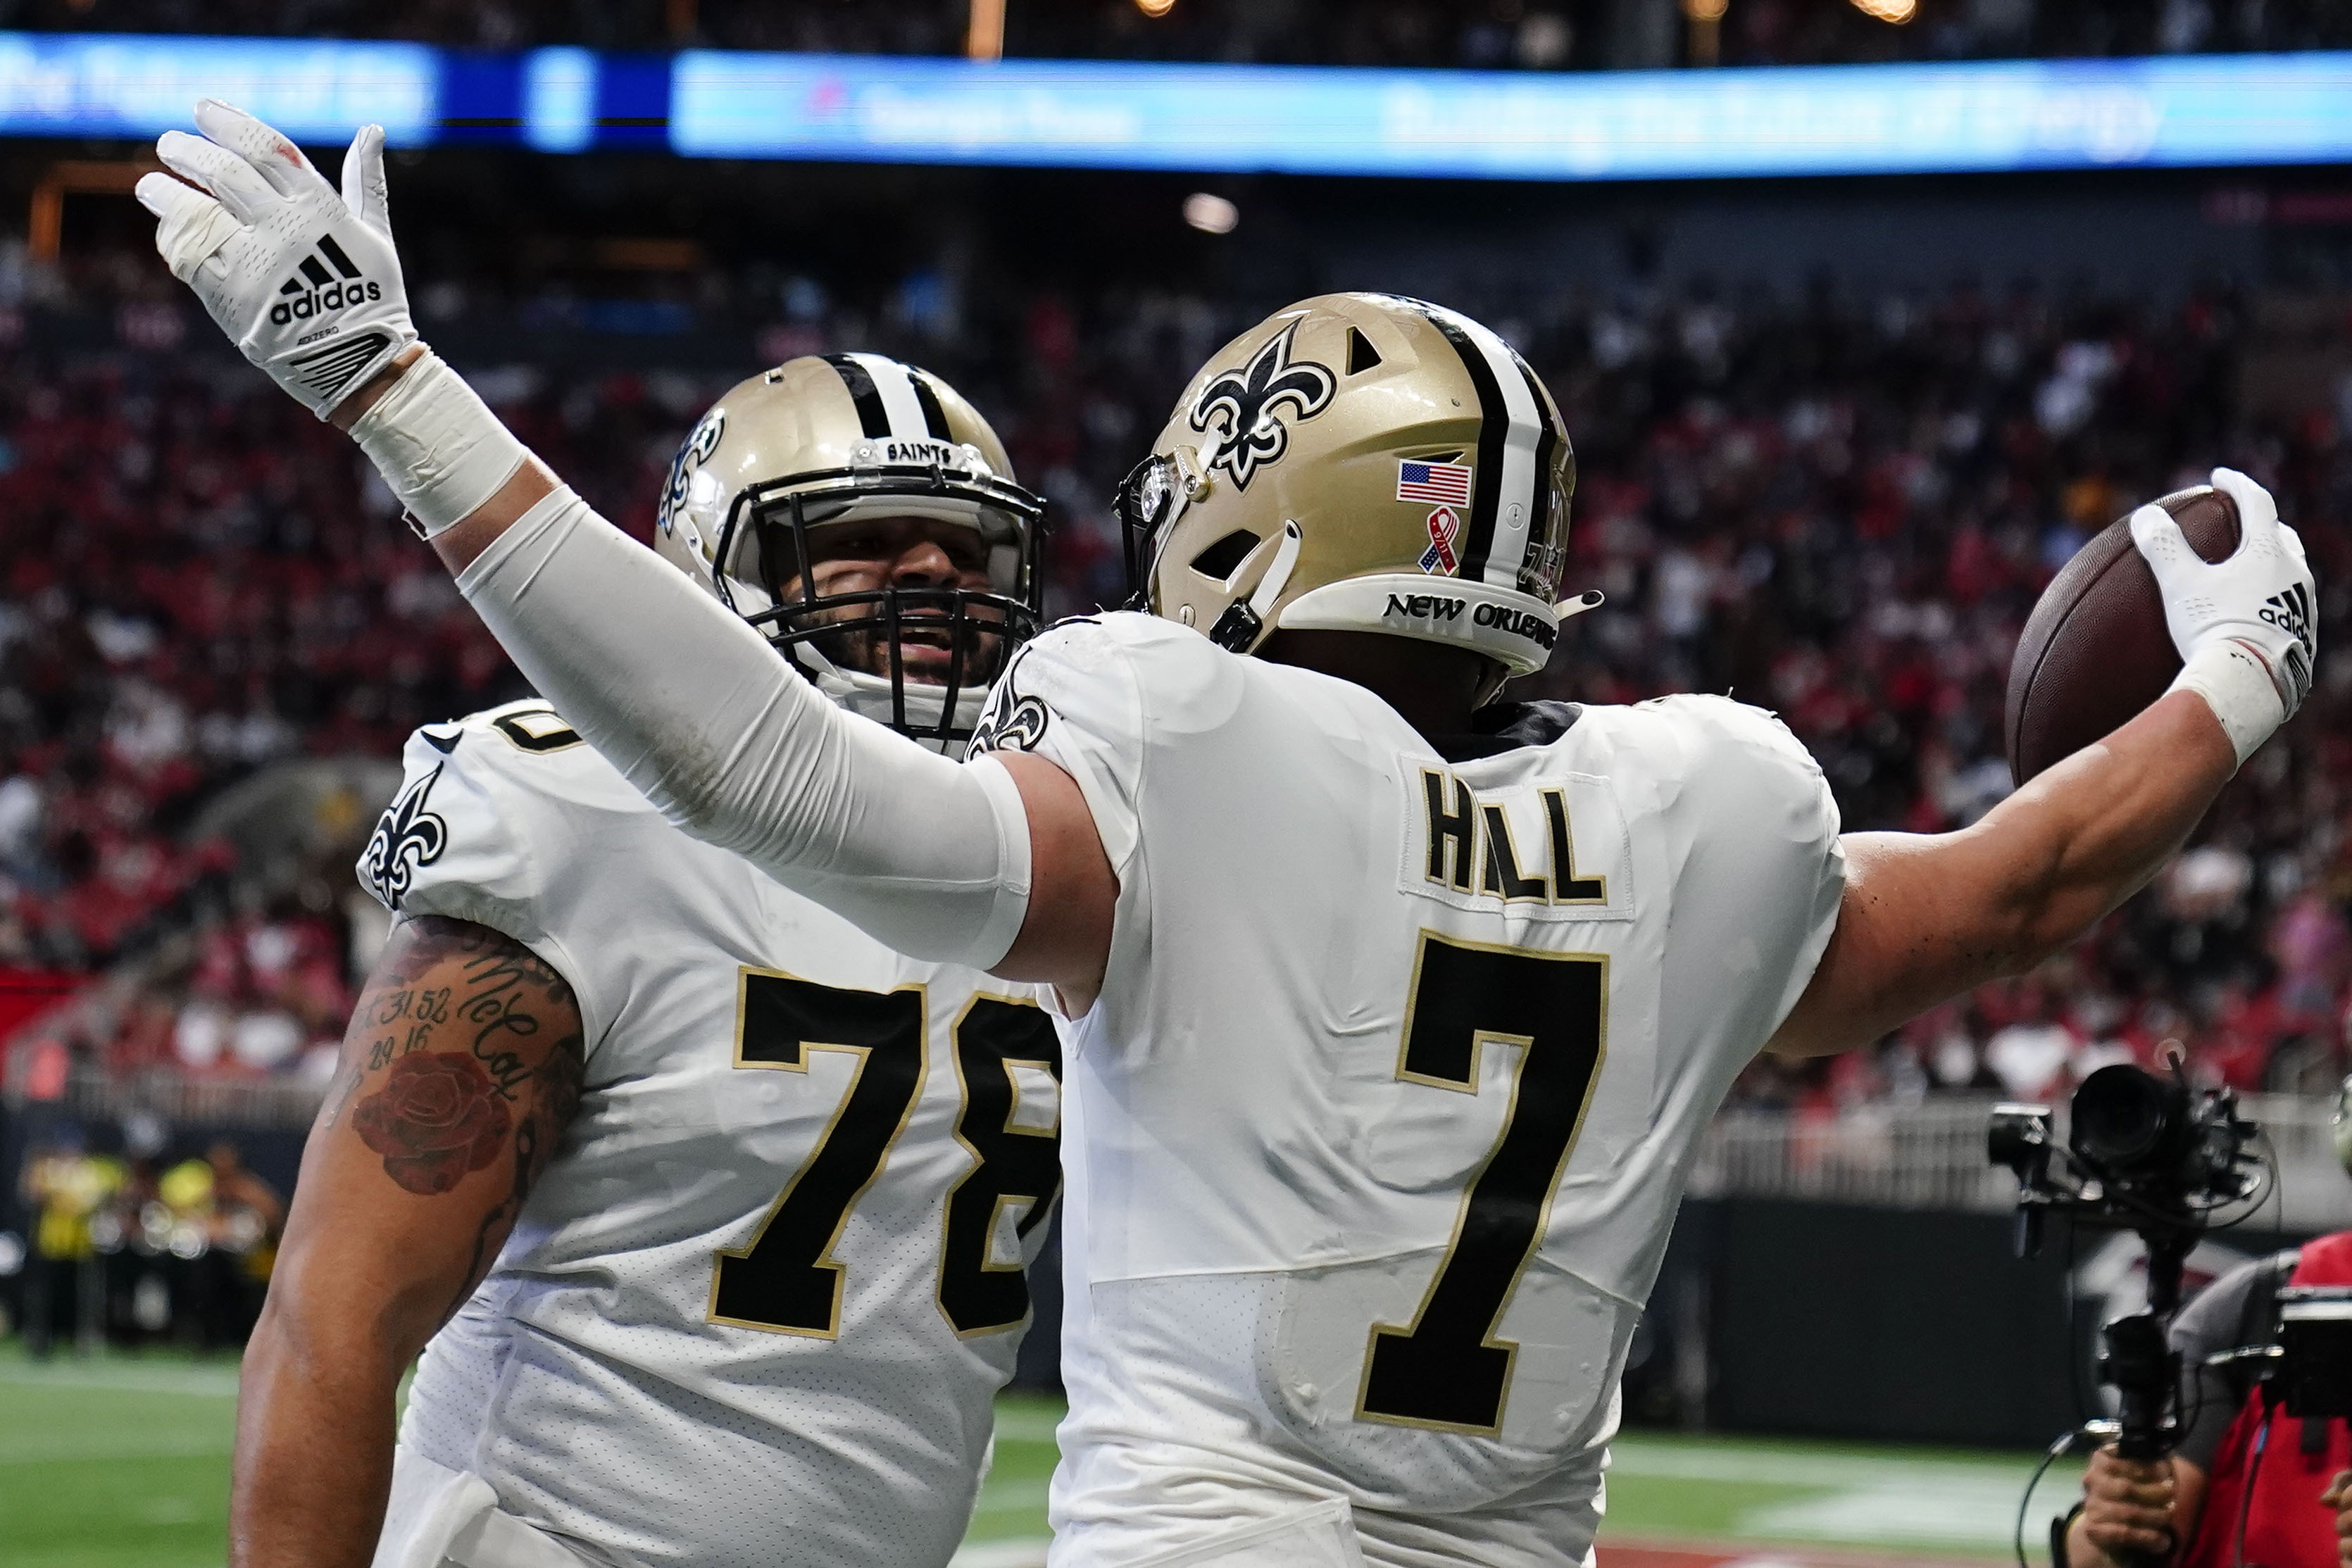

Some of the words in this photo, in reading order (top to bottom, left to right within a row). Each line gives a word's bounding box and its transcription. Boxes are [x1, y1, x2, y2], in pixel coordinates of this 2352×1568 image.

[270, 282, 381, 325] adidas
[887, 444, 950, 464] SAINTS
[705, 965, 1063, 1341] 78
[1353, 927, 1610, 1438] 7
